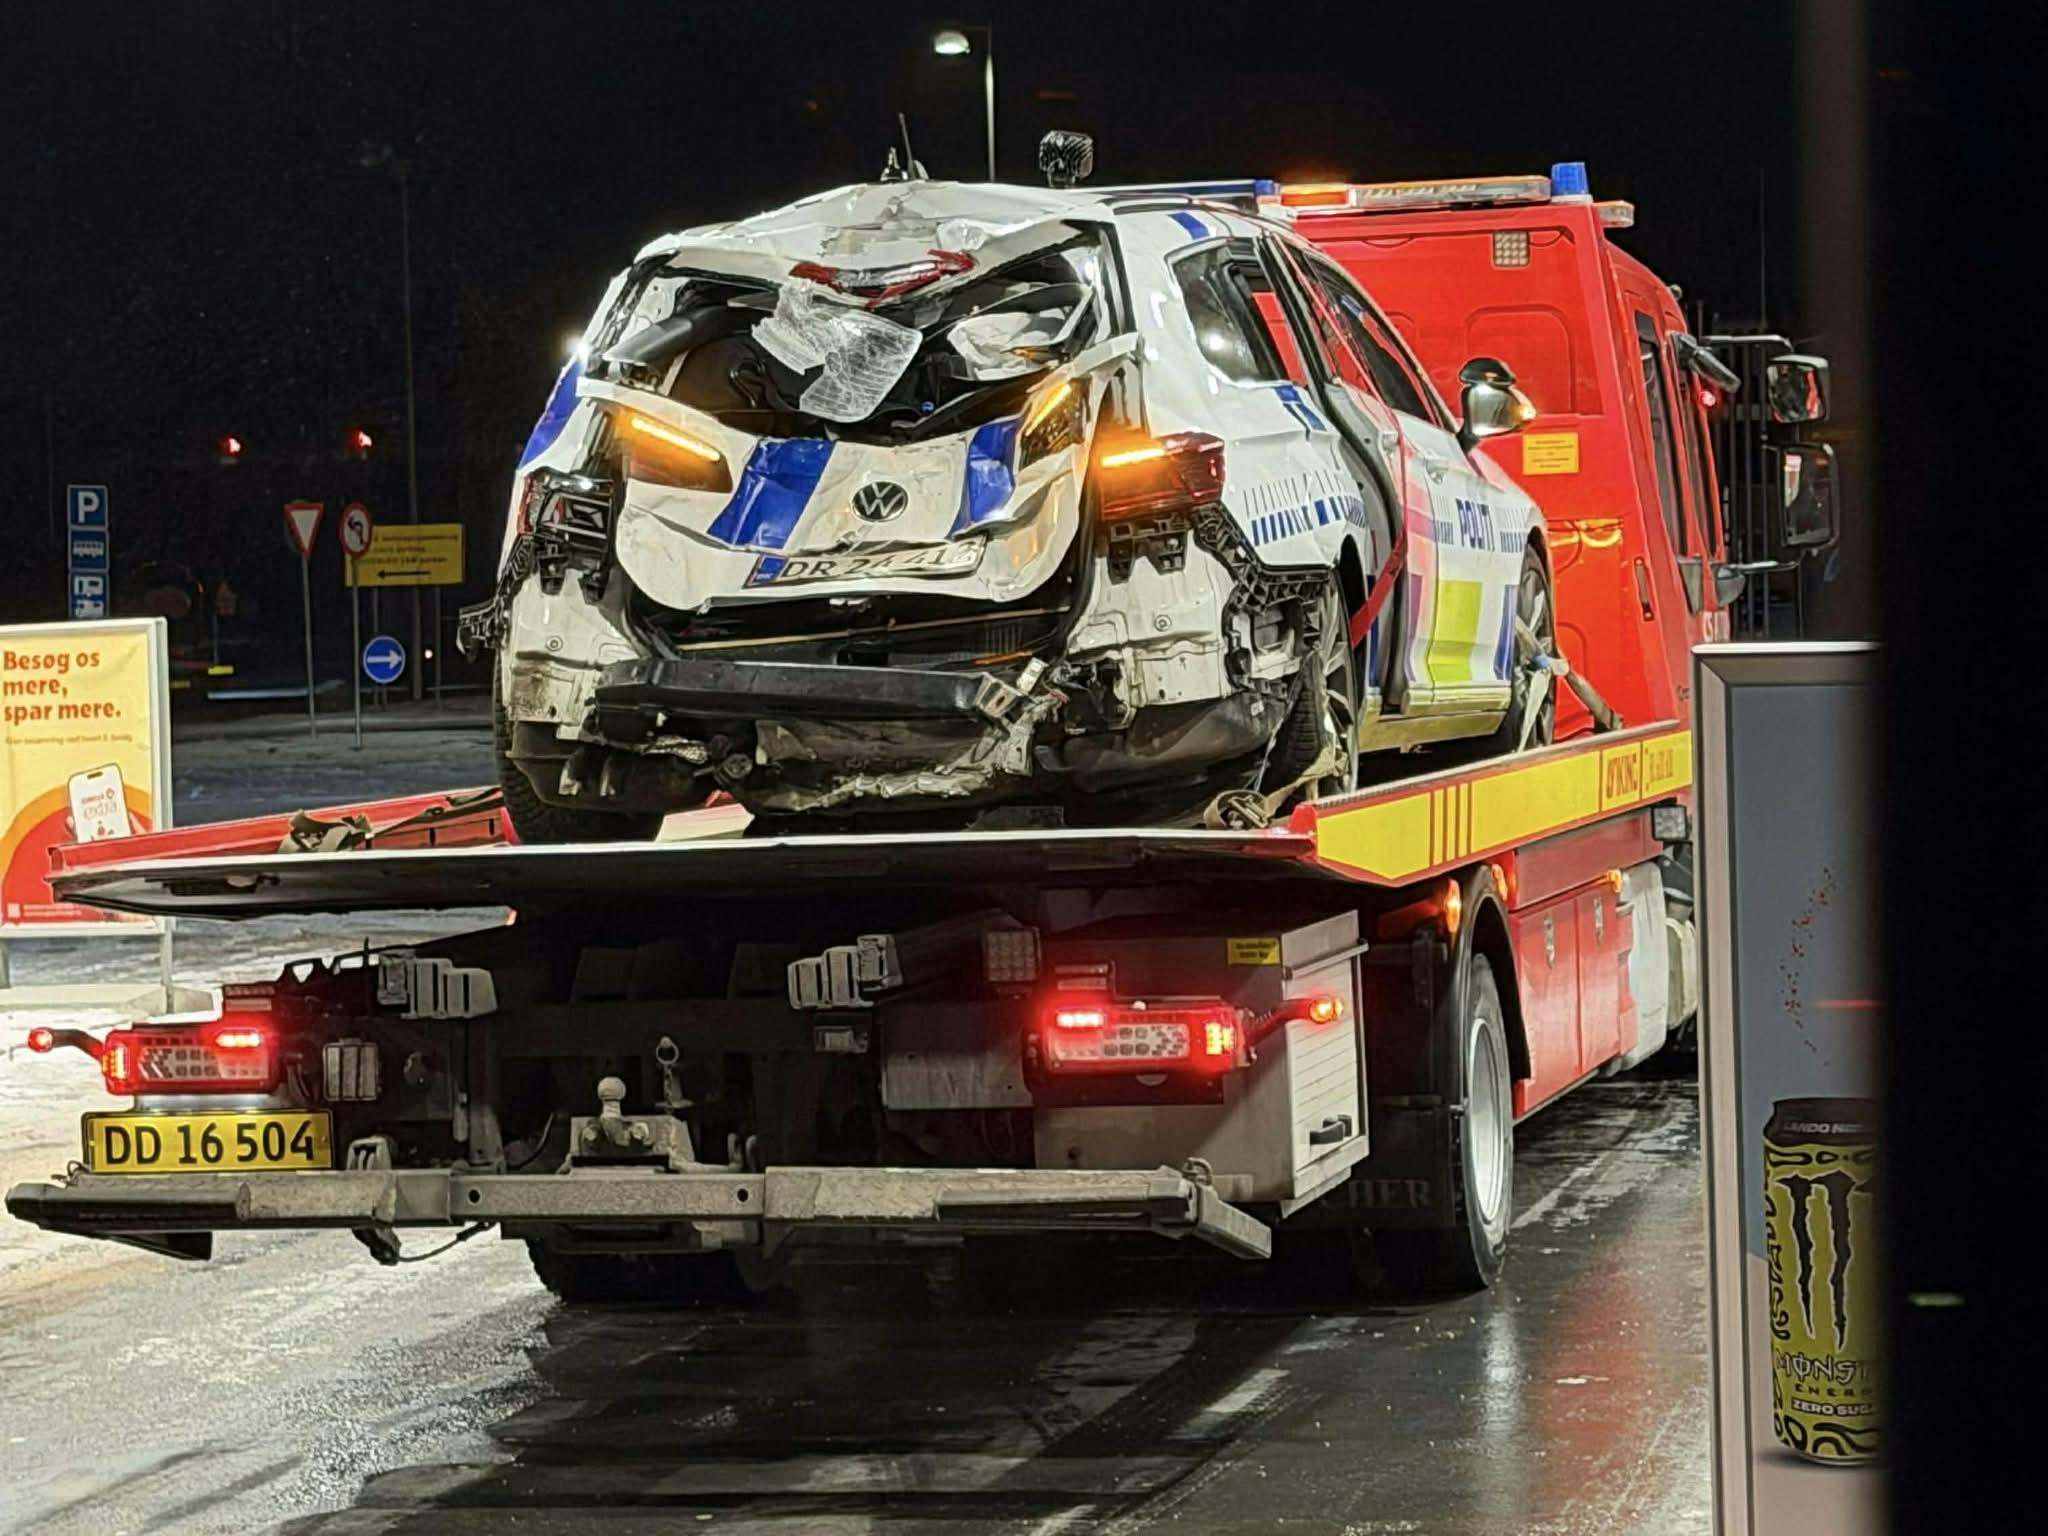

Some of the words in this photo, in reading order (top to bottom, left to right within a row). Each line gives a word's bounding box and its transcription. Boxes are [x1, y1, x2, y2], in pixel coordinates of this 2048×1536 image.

[78, 491, 100, 523] P
[1455, 498, 1496, 551] POLITI
[781, 561, 837, 577] DR
[76, 652, 100, 667] os
[3, 678, 68, 698] mere,
[4, 704, 53, 726] spar
[58, 702, 121, 720] mere.
[105, 1125, 162, 1166] DD
[176, 1122, 224, 1164] 16
[236, 1120, 314, 1162] 504
[1793, 1399, 1834, 1416] ZERO
